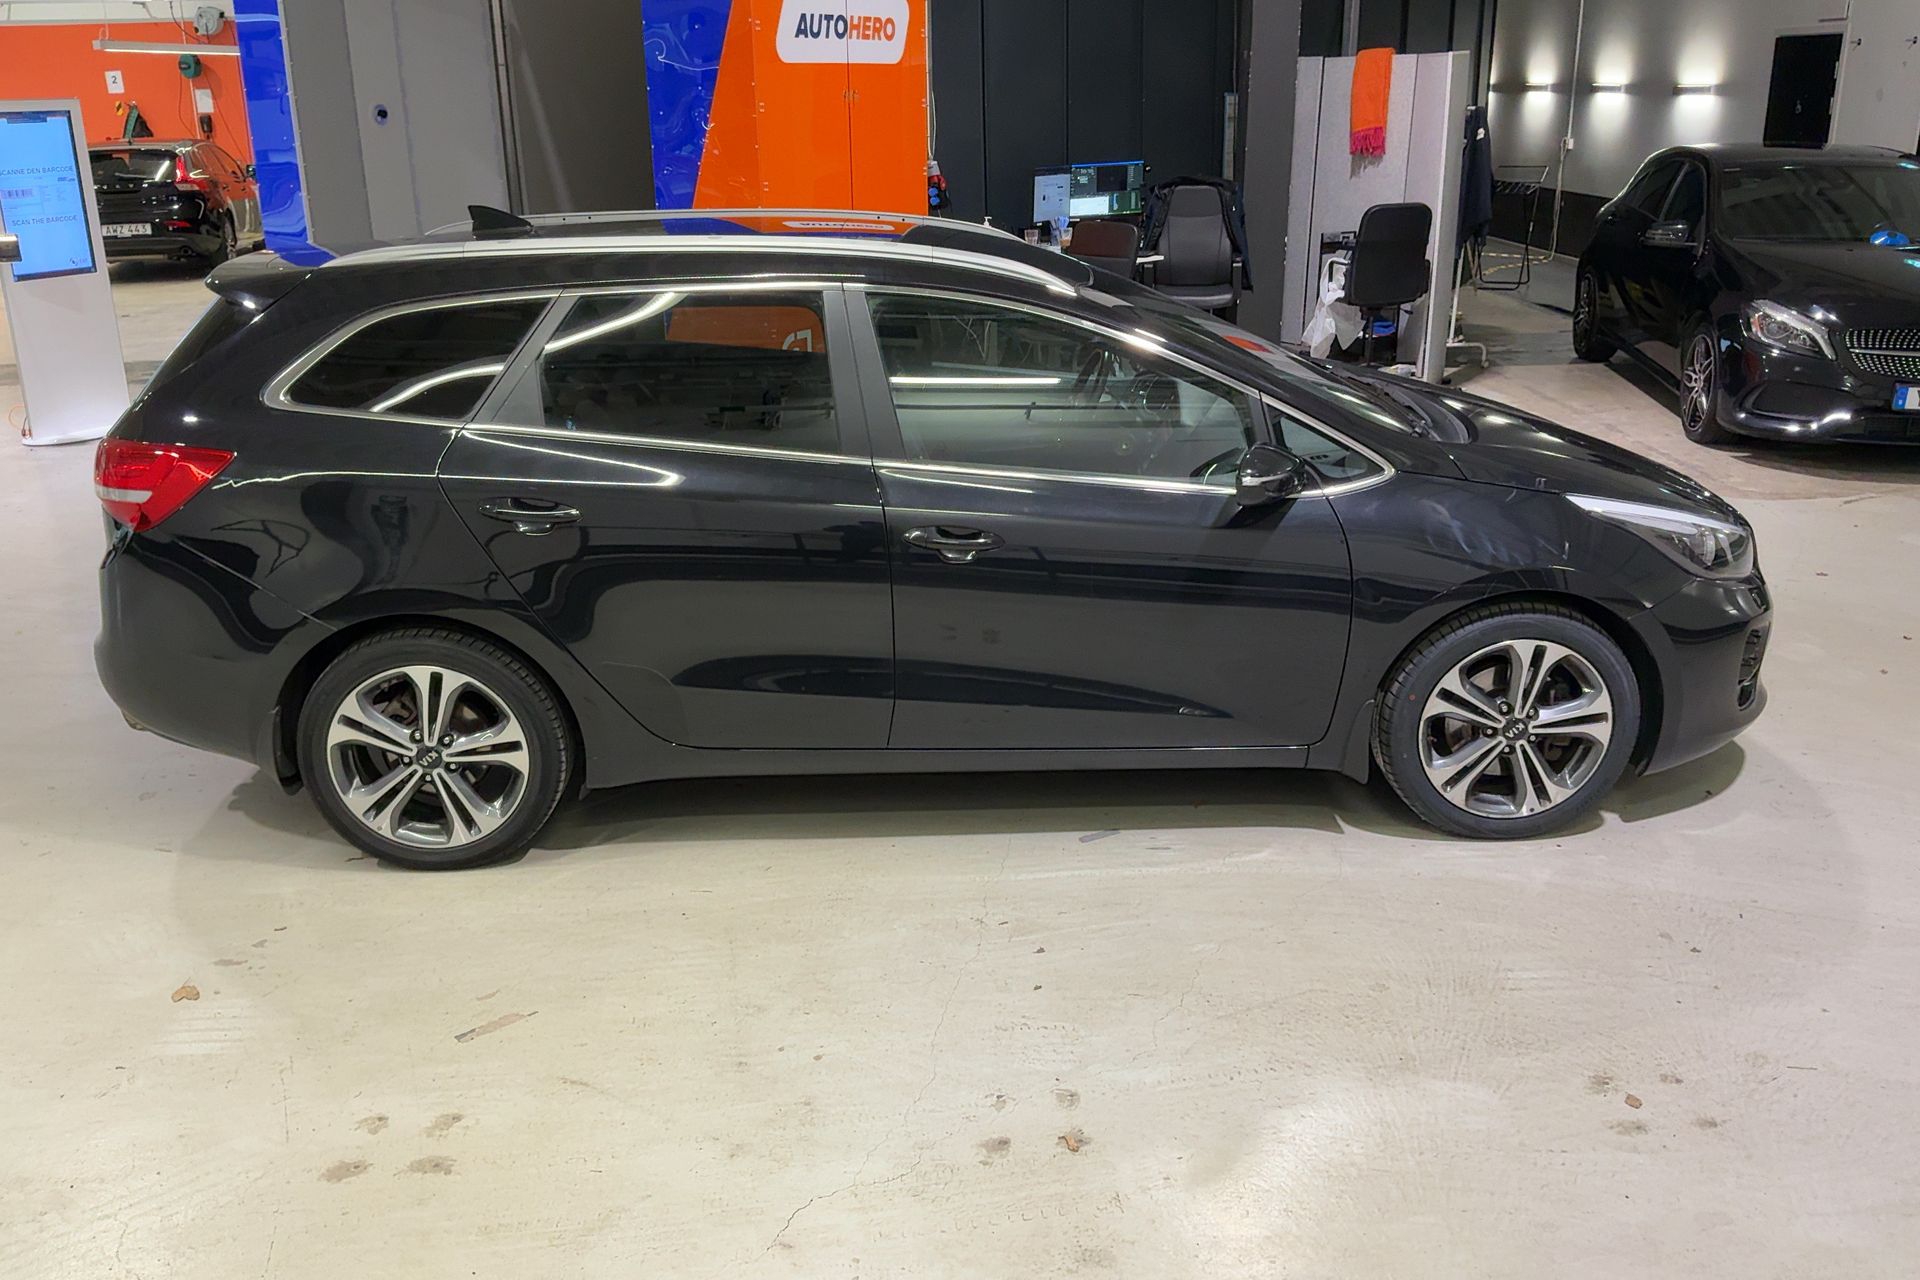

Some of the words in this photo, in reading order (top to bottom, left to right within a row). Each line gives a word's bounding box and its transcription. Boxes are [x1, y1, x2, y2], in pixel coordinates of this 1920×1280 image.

[794, 13, 896, 42] AUTOHERO
[111, 75, 118, 84] 2
[26, 167, 41, 175] DEN
[42, 165, 74, 174] BARCODE
[46, 214, 78, 224] BARCODE
[106, 226, 124, 235] AWZ
[127, 225, 148, 233] 443
[1505, 722, 1526, 738] KIA
[419, 751, 439, 766] KIA
